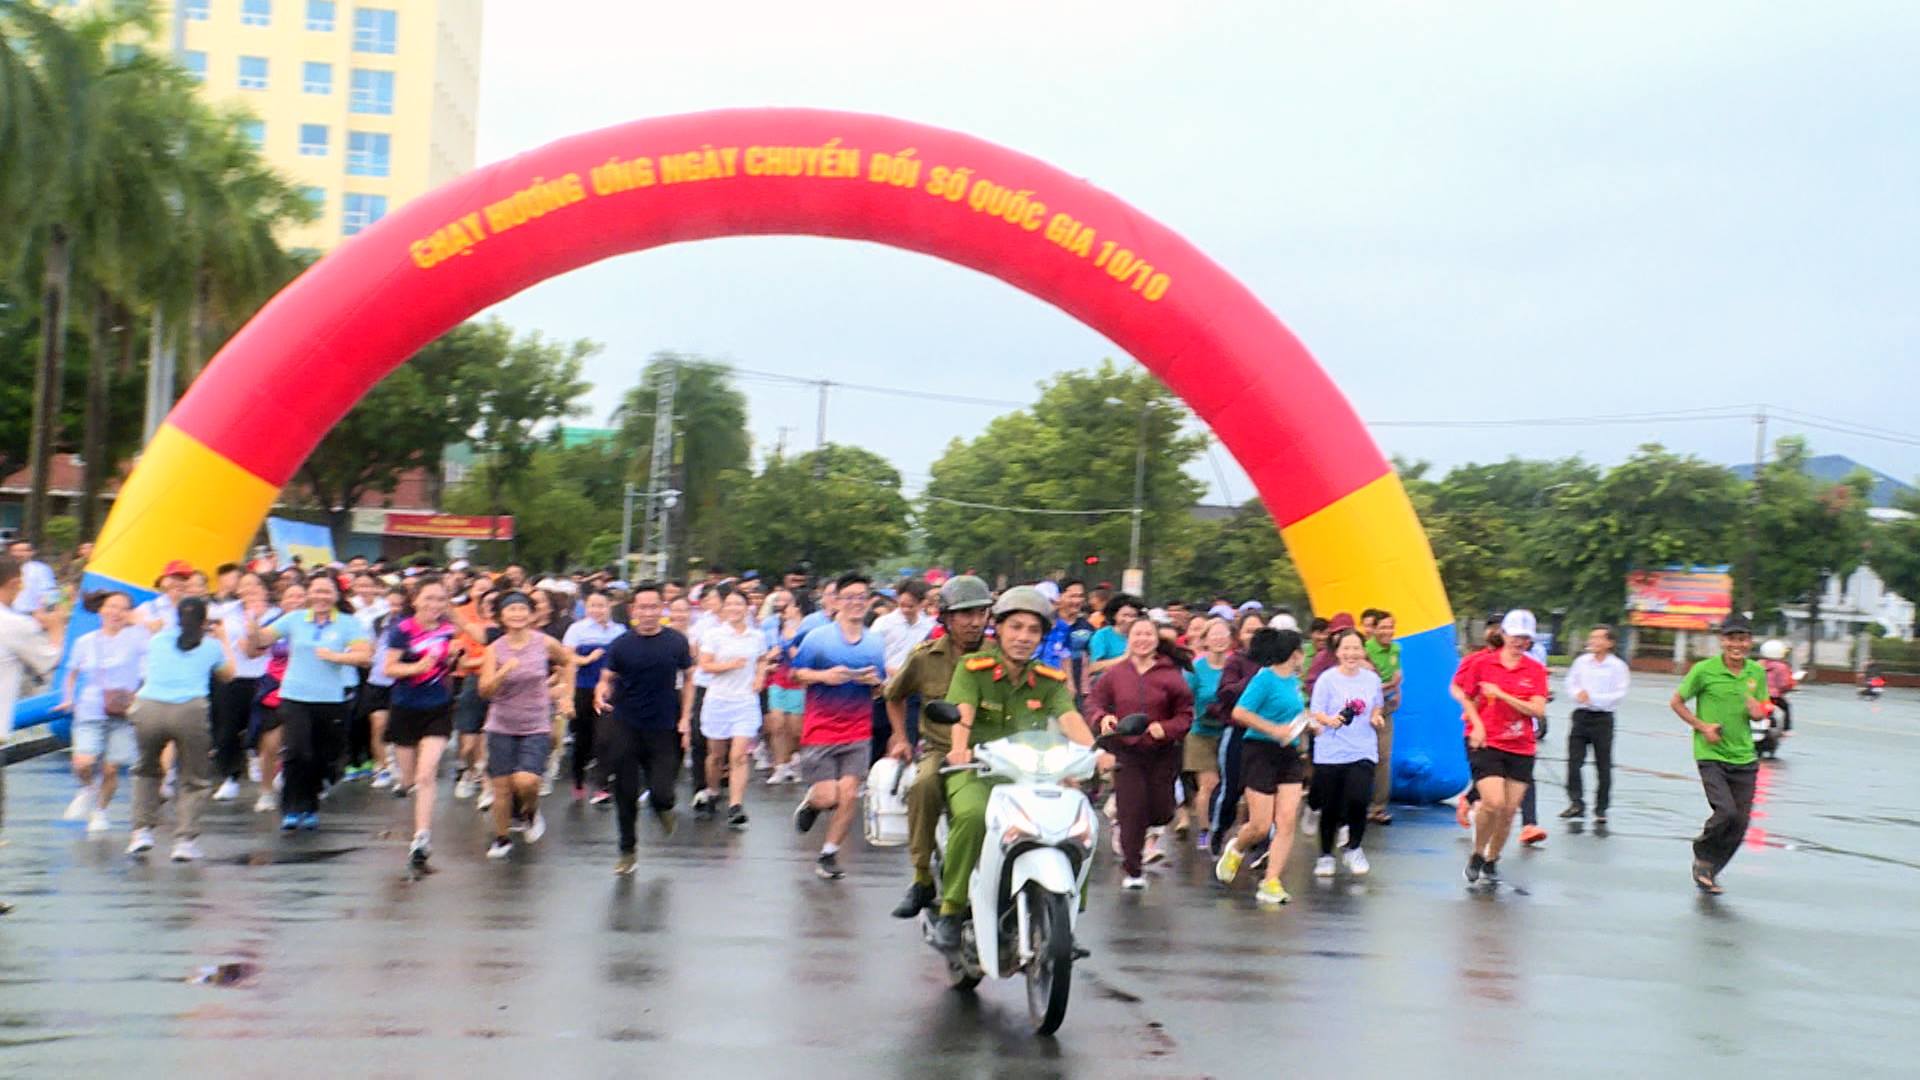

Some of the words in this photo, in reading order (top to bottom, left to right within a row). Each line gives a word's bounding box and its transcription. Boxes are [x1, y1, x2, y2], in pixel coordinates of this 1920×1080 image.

[660, 144, 739, 184] NGÀY
[925, 165, 974, 202] SỐ
[968, 179, 1046, 231] QUỐC
[1045, 213, 1096, 257] GIA
[1095, 241, 1170, 301] 10/10
